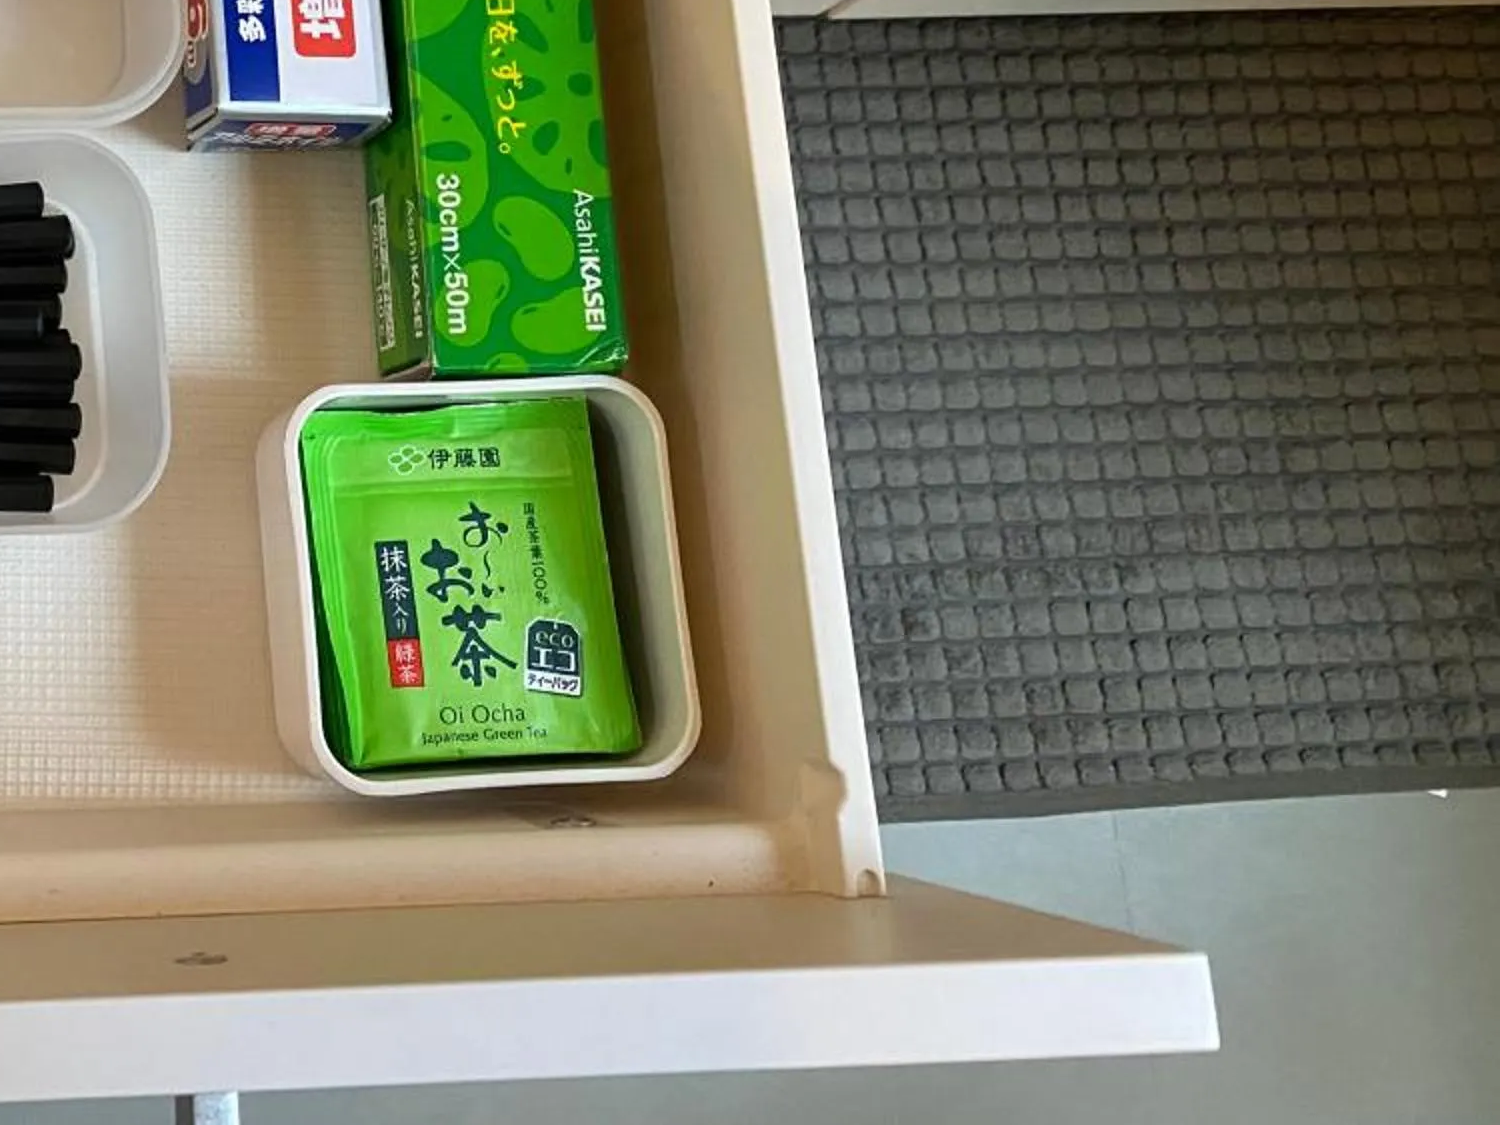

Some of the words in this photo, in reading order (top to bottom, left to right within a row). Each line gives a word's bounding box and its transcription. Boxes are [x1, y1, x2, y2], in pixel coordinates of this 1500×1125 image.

[573, 188, 607, 331] AsahiKASEI
[428, 447, 501, 470] 伊藤園
[380, 546, 410, 635] 抹茶入り
[535, 631, 574, 648] eco
[531, 646, 576, 673] エコ
[440, 706, 464, 725] Oi
[471, 703, 526, 724] Ocha
[421, 732, 479, 747] Japanese
[483, 727, 523, 741] Green
[526, 725, 548, 739] Tea
